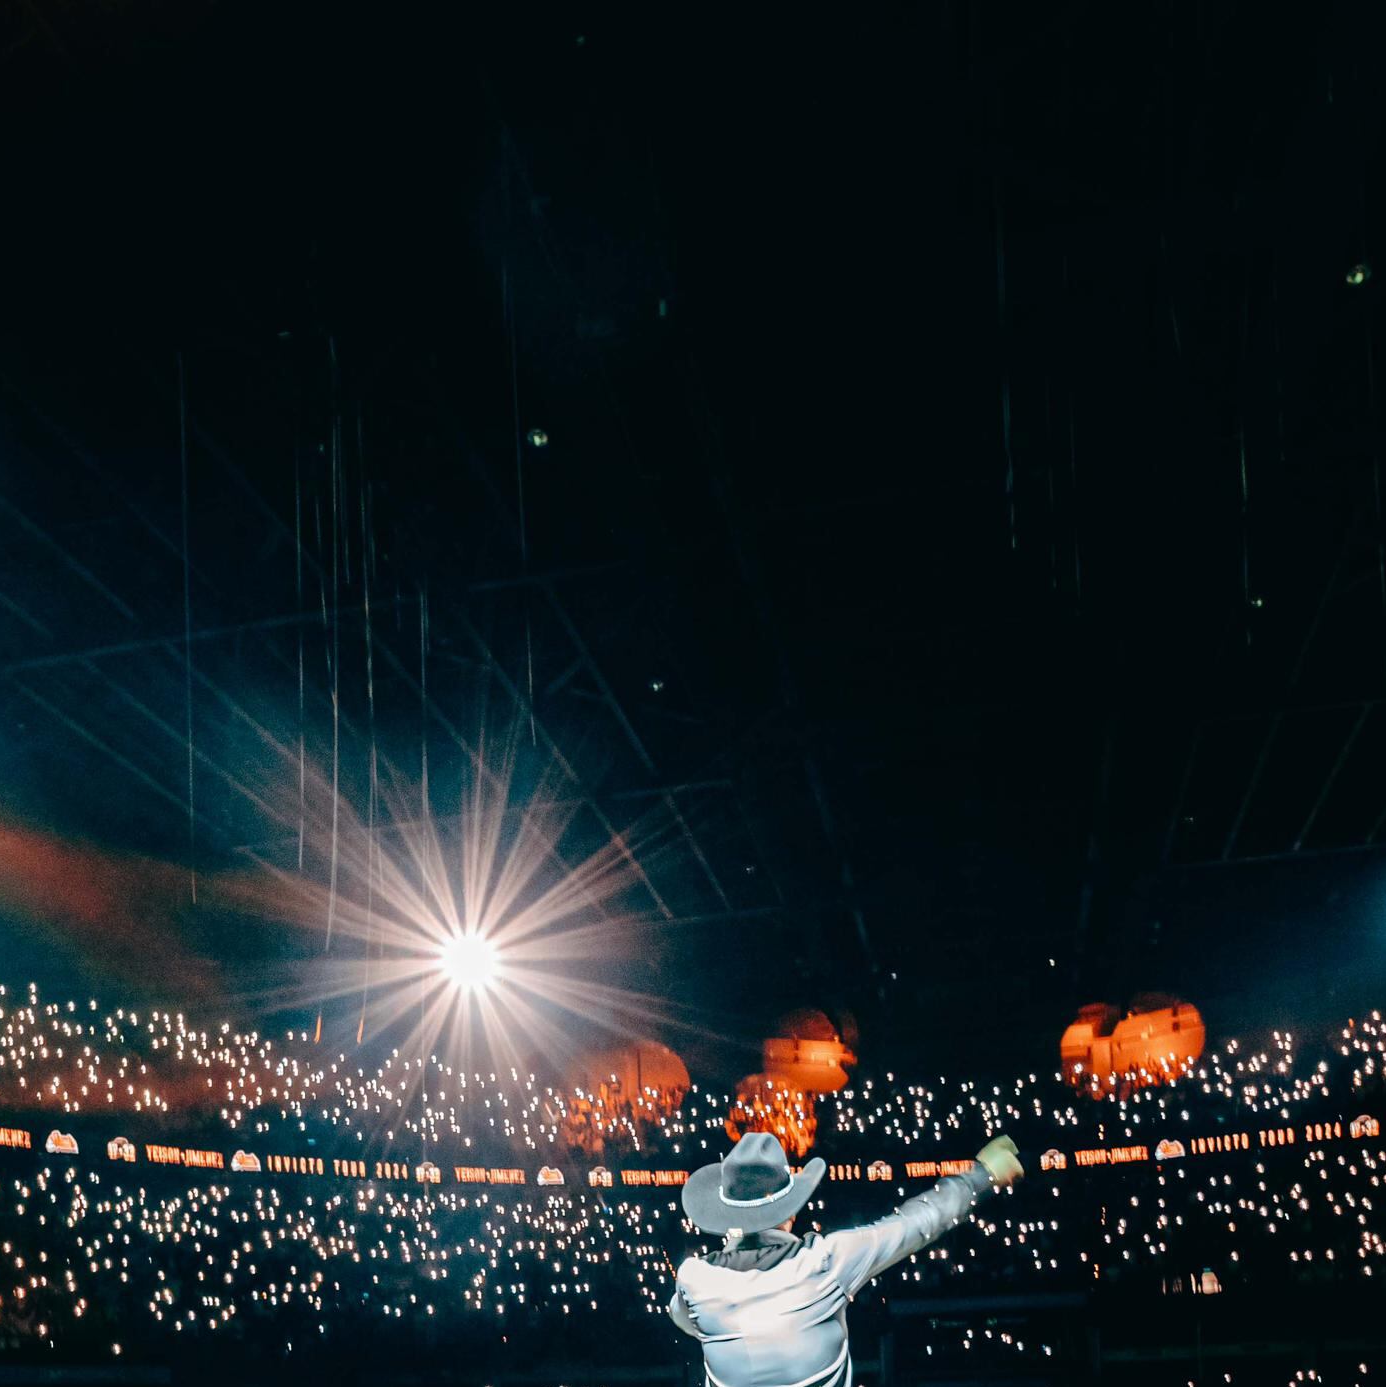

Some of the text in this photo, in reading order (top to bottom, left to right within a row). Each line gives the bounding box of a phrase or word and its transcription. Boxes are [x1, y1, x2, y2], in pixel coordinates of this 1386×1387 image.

[1191, 1132, 1249, 1154] INVICTO
[1306, 1122, 1341, 1142] 2024
[267, 1155, 323, 1175] INVICTO
[376, 1162, 408, 1180] 2024
